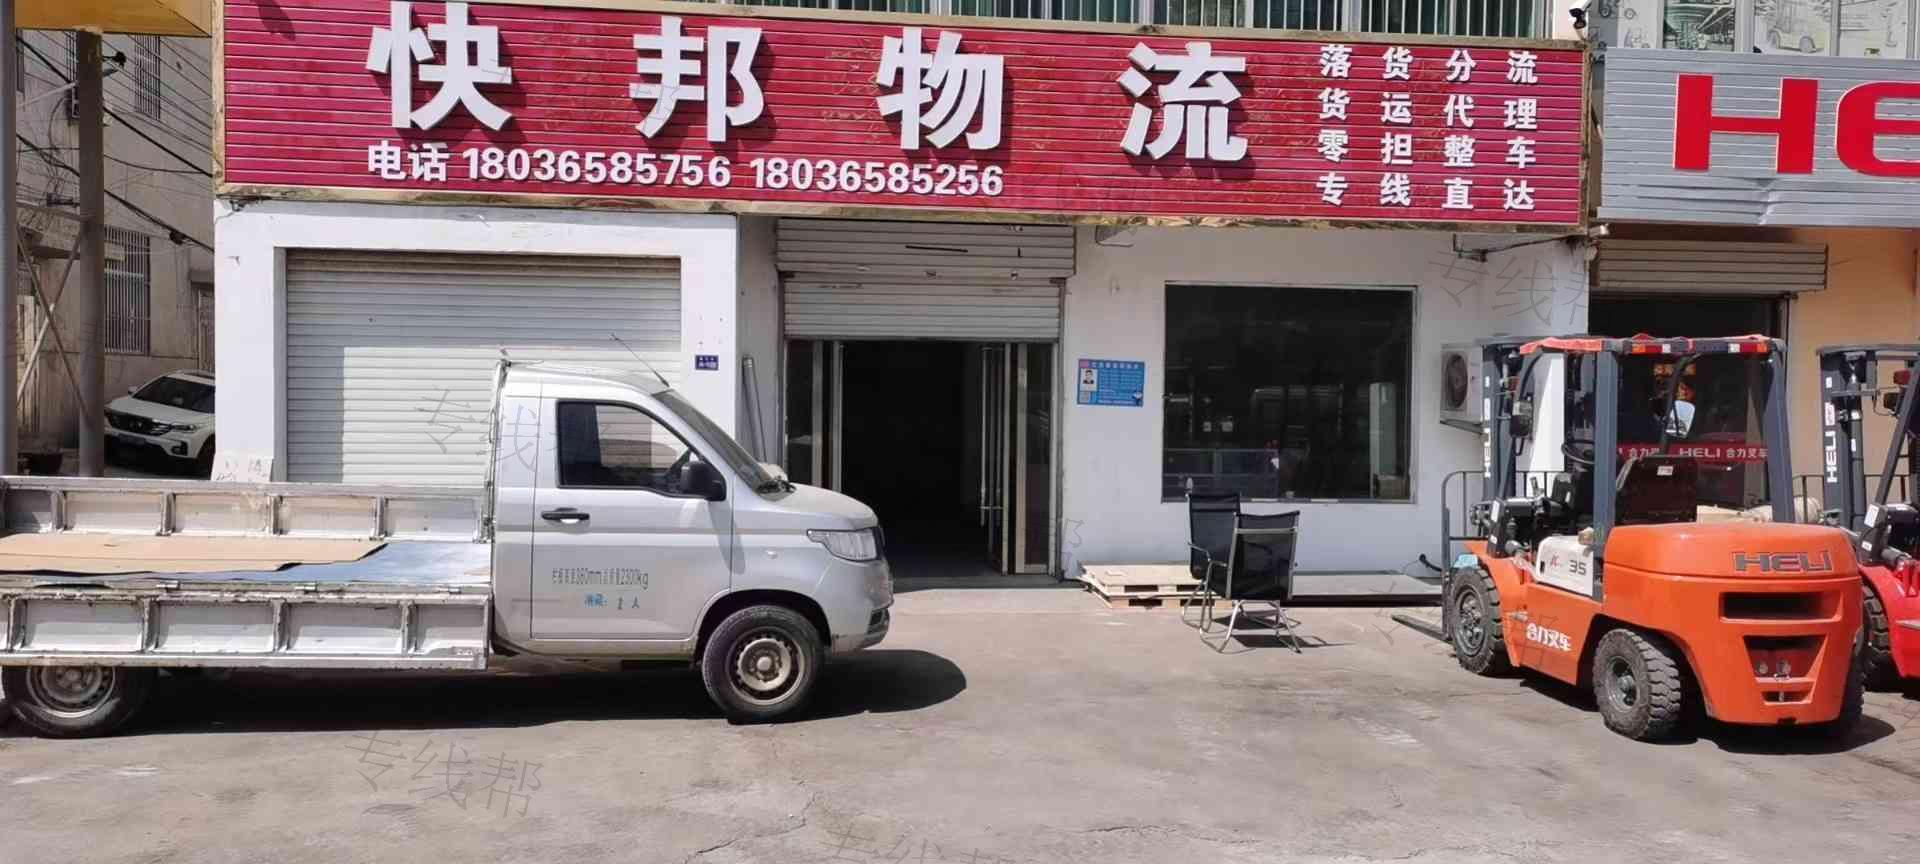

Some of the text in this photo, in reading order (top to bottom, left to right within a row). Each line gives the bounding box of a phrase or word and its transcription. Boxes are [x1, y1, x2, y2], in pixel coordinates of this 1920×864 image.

[366, 1, 1248, 161] 快邦物流
[1319, 44, 1538, 84] 落货分流
[1317, 87, 1538, 130] 货运代理
[1674, 73, 1920, 176] HE
[367, 139, 1004, 197] 电话 18036585756 18036585256
[1317, 129, 1537, 169] 零担整车
[1316, 171, 1536, 211] 专线直达
[1679, 447, 1721, 459] HELI
[1824, 430, 1839, 484] HELI
[1568, 559, 1588, 577] 35
[1731, 551, 1834, 574] HELI
[1526, 622, 1572, 652] 合力叉车
